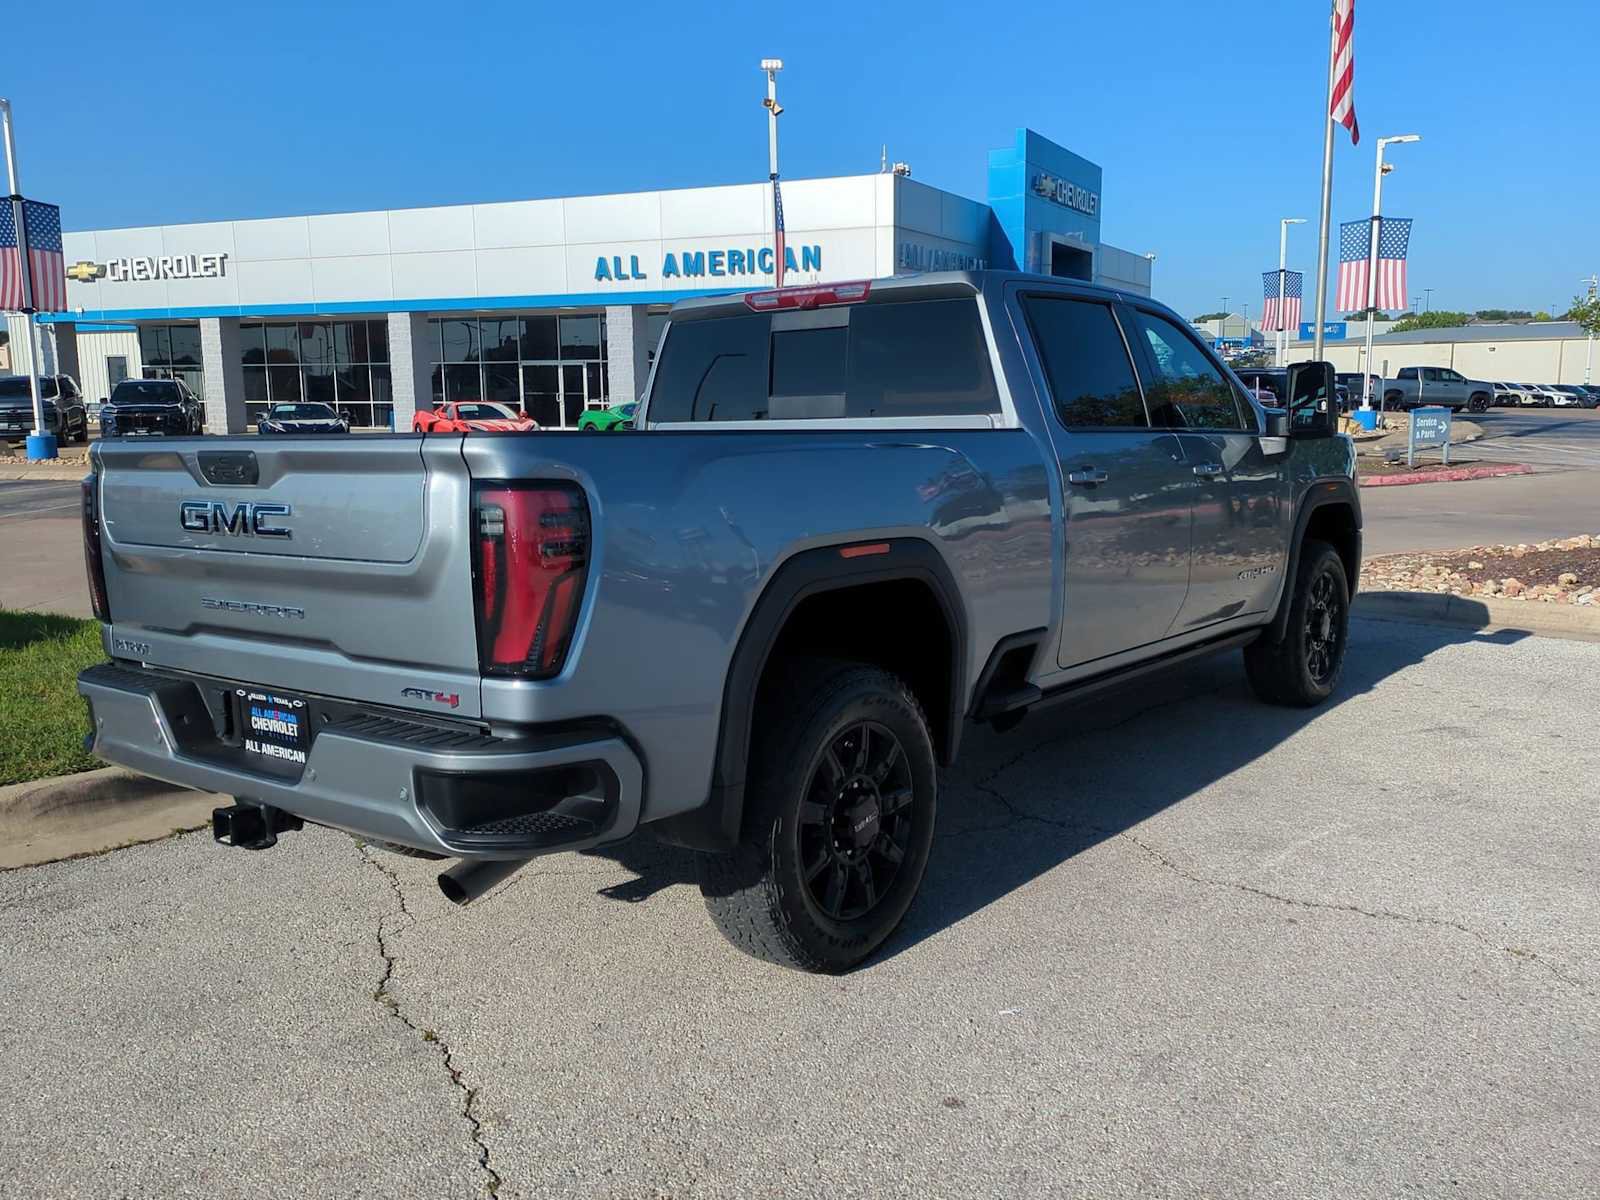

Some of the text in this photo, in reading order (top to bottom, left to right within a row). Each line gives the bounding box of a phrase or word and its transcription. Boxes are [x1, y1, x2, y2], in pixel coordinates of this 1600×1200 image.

[1057, 178, 1098, 216] CHEVROLET
[106, 253, 228, 281] CHEVROLET
[595, 245, 822, 282] ALL AMERICAN
[1416, 417, 1437, 428] Service
[180, 501, 292, 539] GMC
[201, 598, 305, 620] SIERRA
[251, 716, 298, 737] CHEVROLET
[245, 740, 306, 764] ALL AMERICAN
